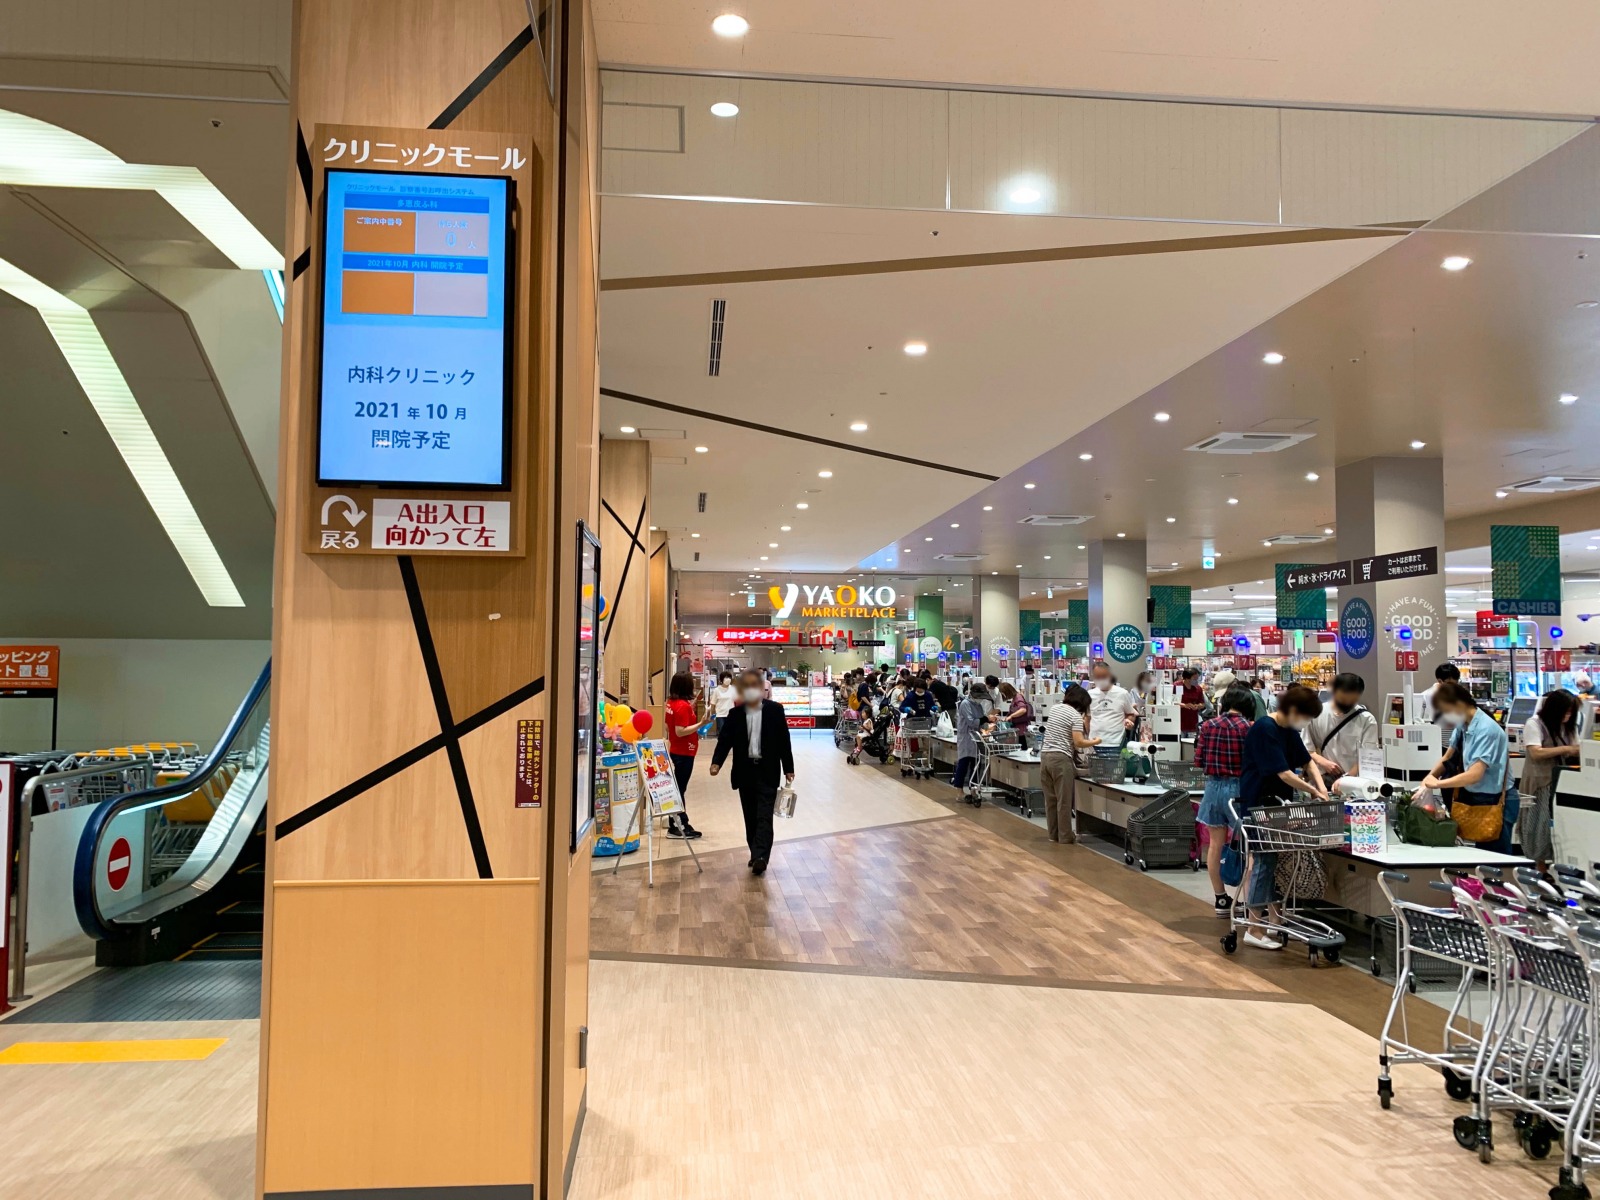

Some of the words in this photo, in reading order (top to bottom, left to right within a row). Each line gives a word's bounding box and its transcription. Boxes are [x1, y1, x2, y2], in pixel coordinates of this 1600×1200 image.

[323, 138, 527, 171] クリニックモール
[346, 183, 396, 192] クリニックモール
[356, 216, 403, 226] ご案内中番号
[367, 259, 409, 269] 2021年10月
[412, 260, 428, 269] 内科
[431, 260, 464, 271] 開院予定
[347, 365, 476, 386] 内科クリニック
[354, 401, 400, 418] 2021
[407, 407, 420, 420] 年
[426, 403, 448, 420] 10
[454, 408, 467, 420] 月
[371, 430, 451, 450] 開院予定
[397, 503, 485, 525] A出入口
[320, 530, 360, 549] 戻る
[385, 524, 496, 548] 向かって左
[1387, 563, 1429, 575] ご利用いただけます。
[803, 585, 896, 606] YAOKO
[1345, 603, 1356, 617] HAVE
[1360, 602, 1368, 615] FUN
[1389, 596, 1410, 612] HAVE
[1418, 598, 1435, 613] FUN
[1497, 601, 1557, 614] CASHIER
[802, 607, 896, 618] MARKETPLACE
[1280, 619, 1324, 629] CASHIER
[1346, 617, 1367, 628] GOOD
[1391, 615, 1433, 627] GOOD
[723, 630, 784, 640] コージーコーナー
[1112, 626, 1125, 636] HAVE
[1128, 627, 1138, 636] FUN
[1347, 629, 1367, 639] FOOD
[1393, 628, 1433, 640] FOD
[1345, 643, 1358, 655] MEAL
[1358, 642, 1368, 655] TIME
[1419, 643, 1435, 657] IME
[1113, 651, 1126, 660] MEAL
[1127, 652, 1138, 660] TIME
[1242, 657, 1247, 666] 7
[1398, 655, 1403, 665] 5
[1408, 655, 1415, 665] 5
[1547, 655, 1553, 665] 6
[1559, 655, 1567, 665] 6
